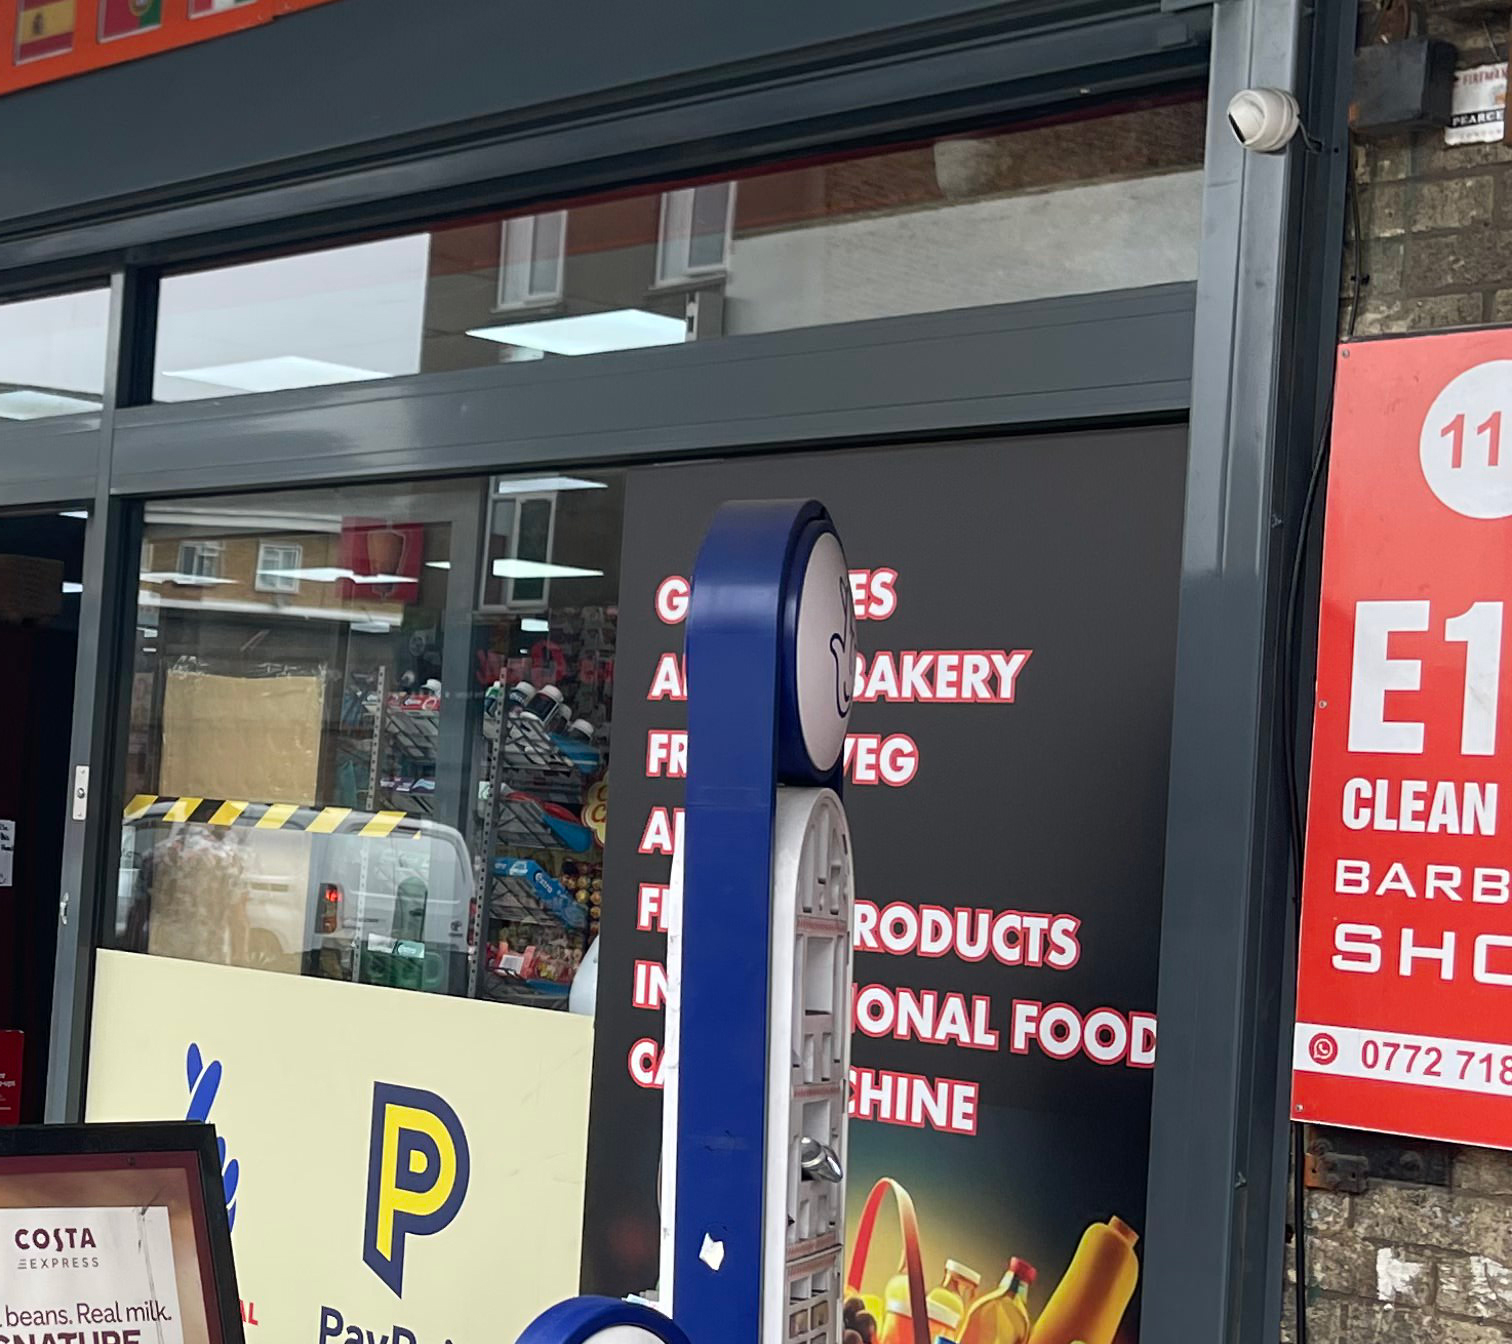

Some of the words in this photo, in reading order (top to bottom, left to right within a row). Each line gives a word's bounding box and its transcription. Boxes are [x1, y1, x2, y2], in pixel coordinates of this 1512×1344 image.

[1347, 599, 1504, 756] E1
[1341, 777, 1498, 836] CLEAN
[1335, 858, 1511, 904] BARB
[852, 899, 1082, 971] RODUCTS
[1361, 1039, 1443, 1077] 0772
[14, 1227, 97, 1252] COSTA
[29, 1257, 100, 1269] EXPRESS
[5, 1304, 73, 1327] beans.
[76, 1300, 122, 1324] Real
[125, 1299, 172, 1322] milk.
